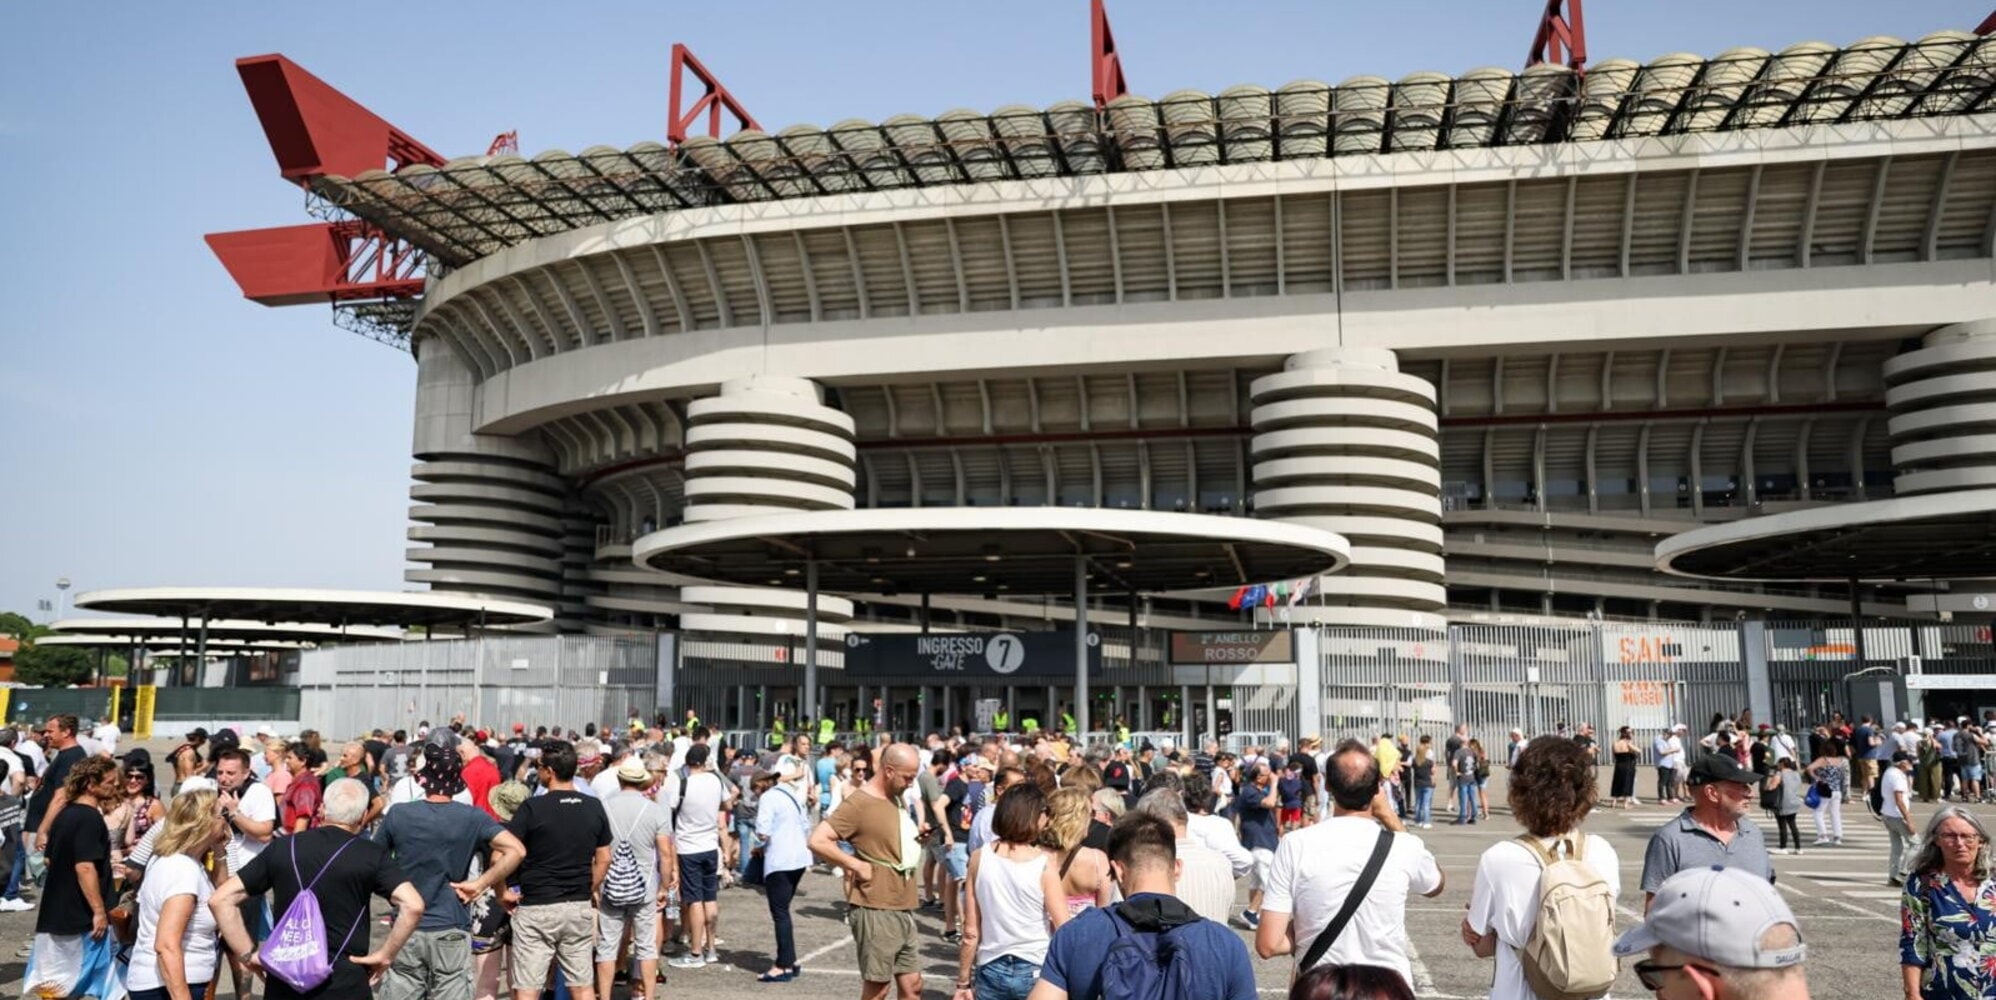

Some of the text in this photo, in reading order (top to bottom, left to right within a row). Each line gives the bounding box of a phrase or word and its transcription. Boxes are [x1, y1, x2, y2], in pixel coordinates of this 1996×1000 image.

[917, 637, 983, 655] INGRESSO
[1215, 634, 1261, 645] ANELLO
[998, 639, 1011, 668] 7
[1205, 648, 1258, 661] ROSSO
[932, 655, 965, 670] GATE
